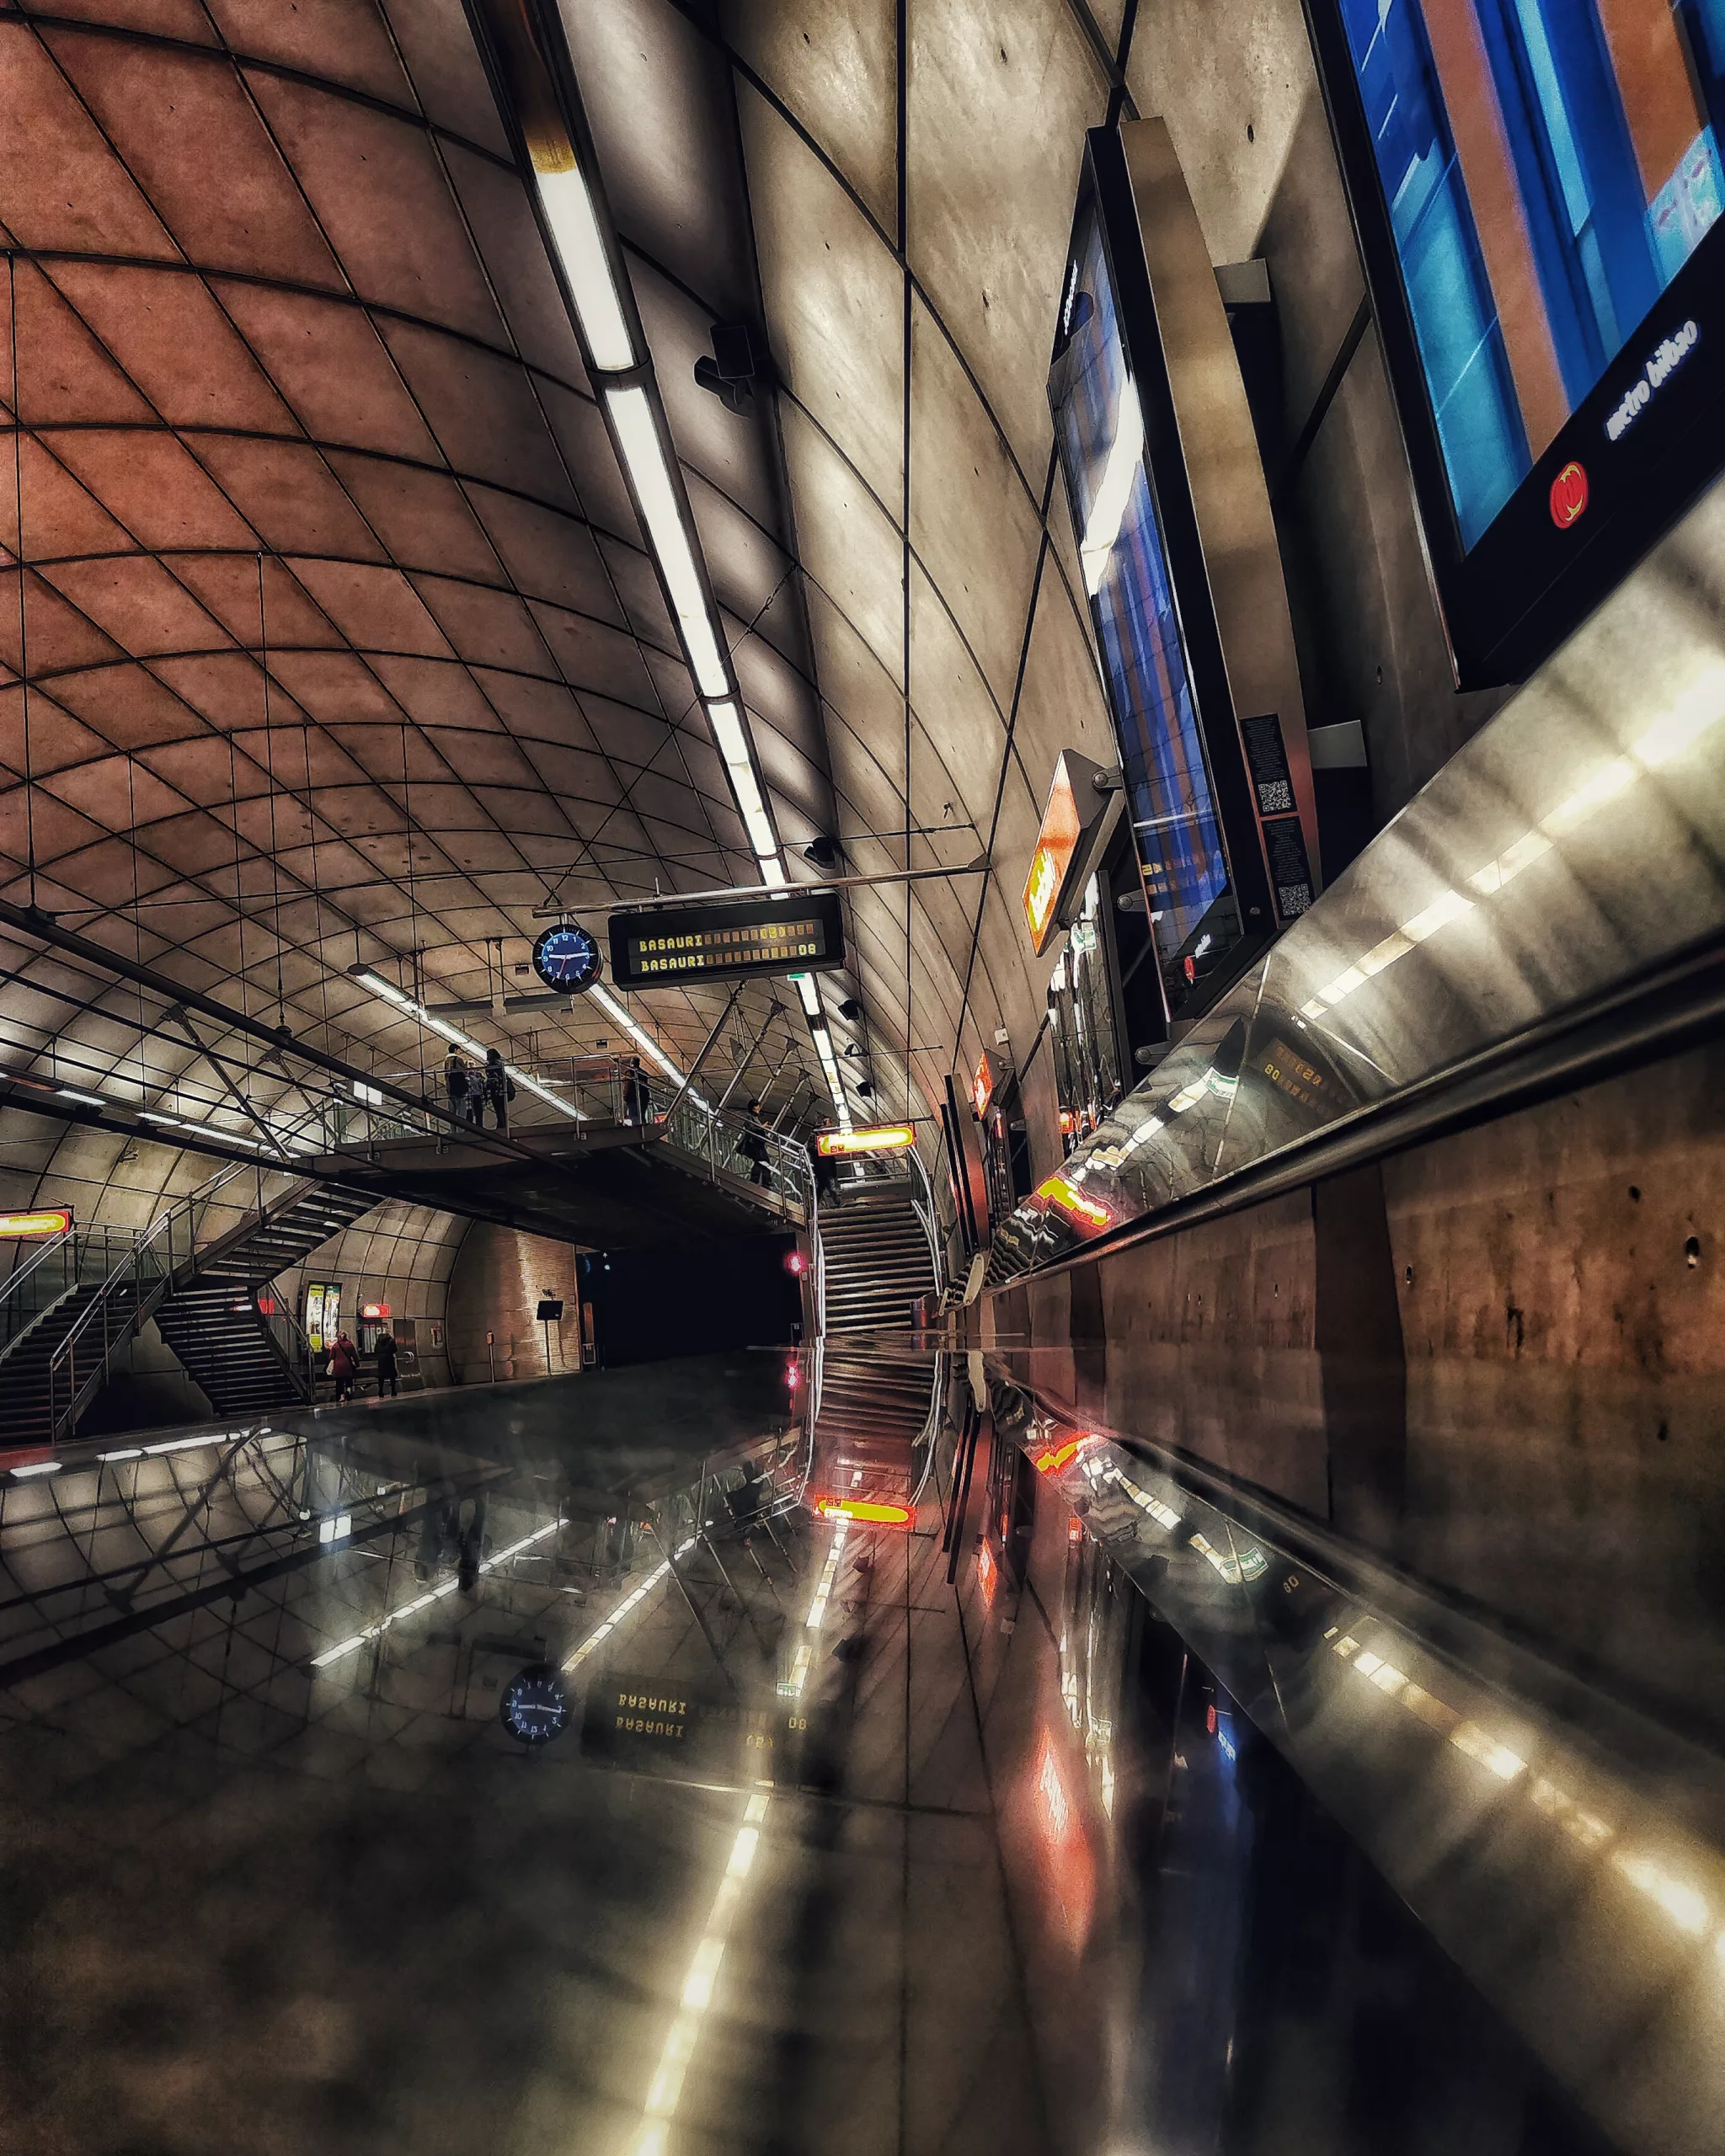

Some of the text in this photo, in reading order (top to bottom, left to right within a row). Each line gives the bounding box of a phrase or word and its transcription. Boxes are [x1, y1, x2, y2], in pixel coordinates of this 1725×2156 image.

[639, 935, 703, 953] BASAURI
[640, 943, 816, 972] BASAURI 08
